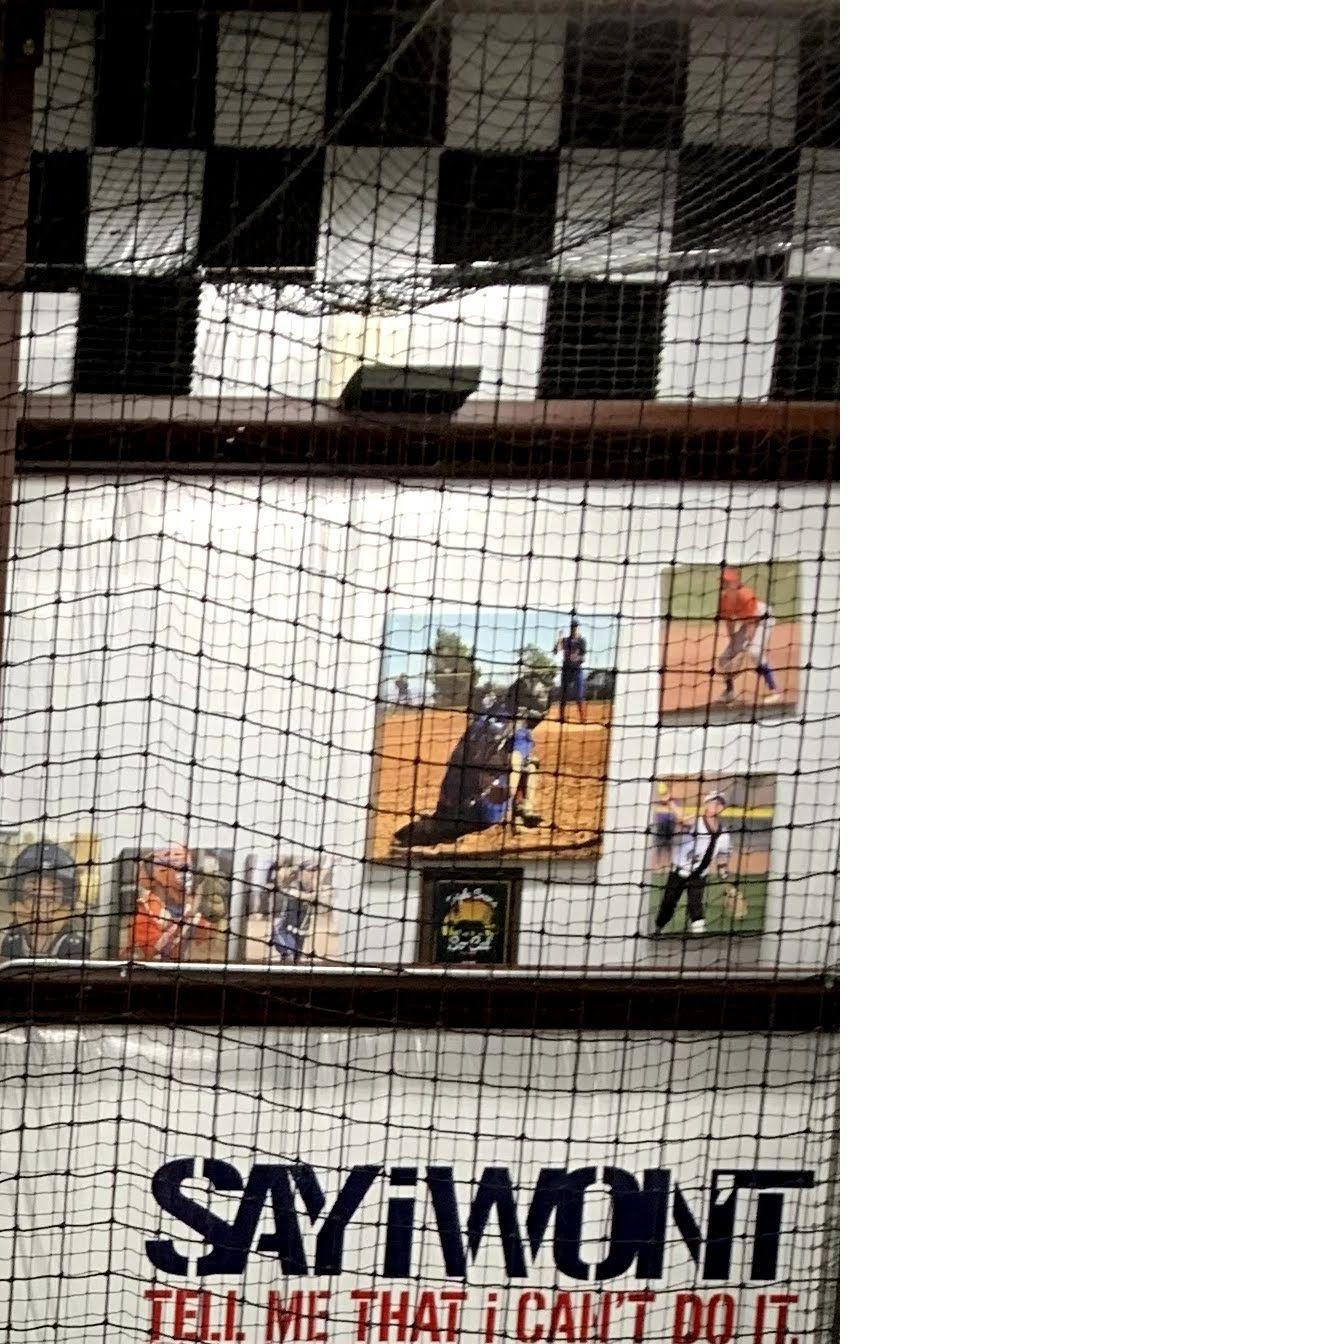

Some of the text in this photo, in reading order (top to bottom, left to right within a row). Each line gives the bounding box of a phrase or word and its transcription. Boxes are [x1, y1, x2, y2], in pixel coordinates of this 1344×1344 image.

[144, 1289, 245, 1342] TELL
[265, 1290, 332, 1342] ME
[351, 1290, 467, 1343] THAT
[516, 1291, 656, 1344] CAN'T
